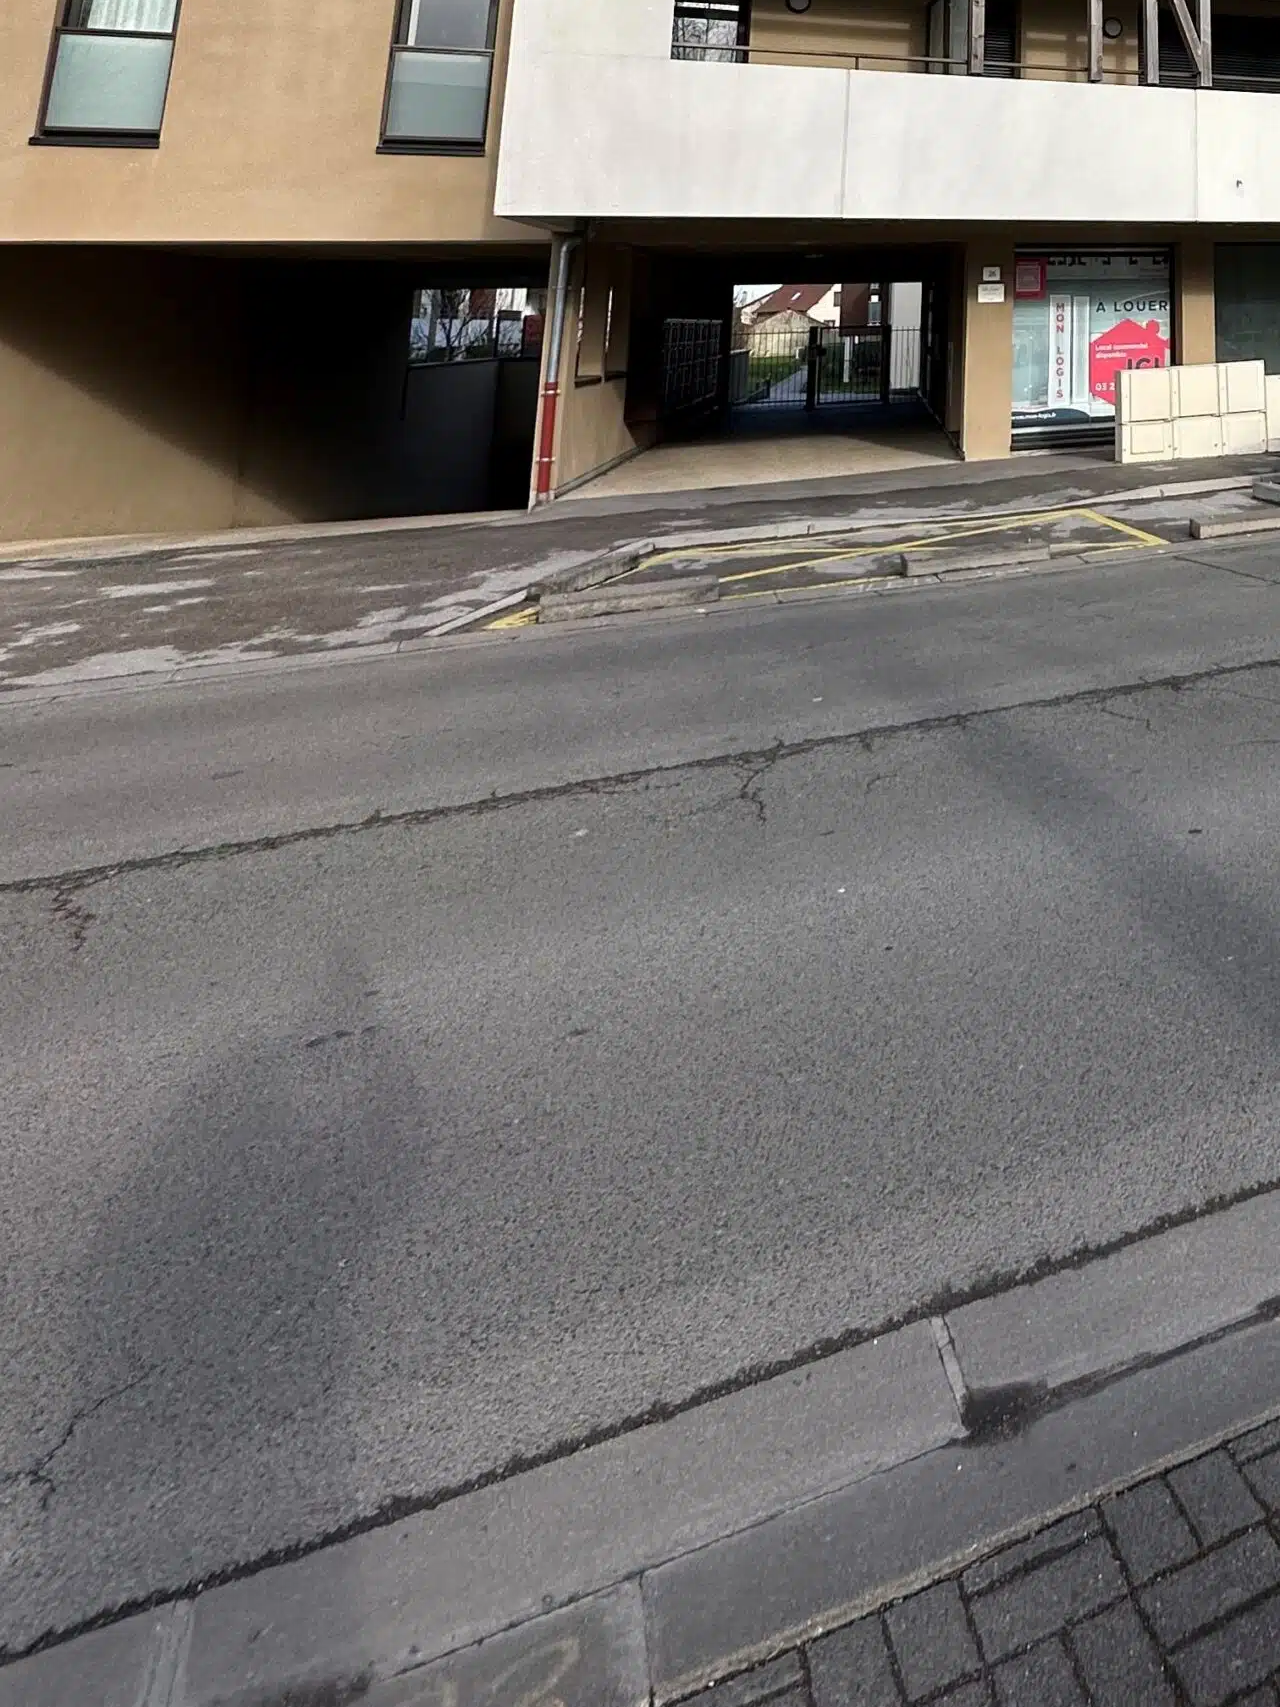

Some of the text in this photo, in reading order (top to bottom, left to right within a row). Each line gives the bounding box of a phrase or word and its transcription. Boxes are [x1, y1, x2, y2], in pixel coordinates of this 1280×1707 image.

[1056, 302, 1065, 333] MON
[1114, 300, 1169, 312] LOUER
[1056, 346, 1065, 399] LOGIS
